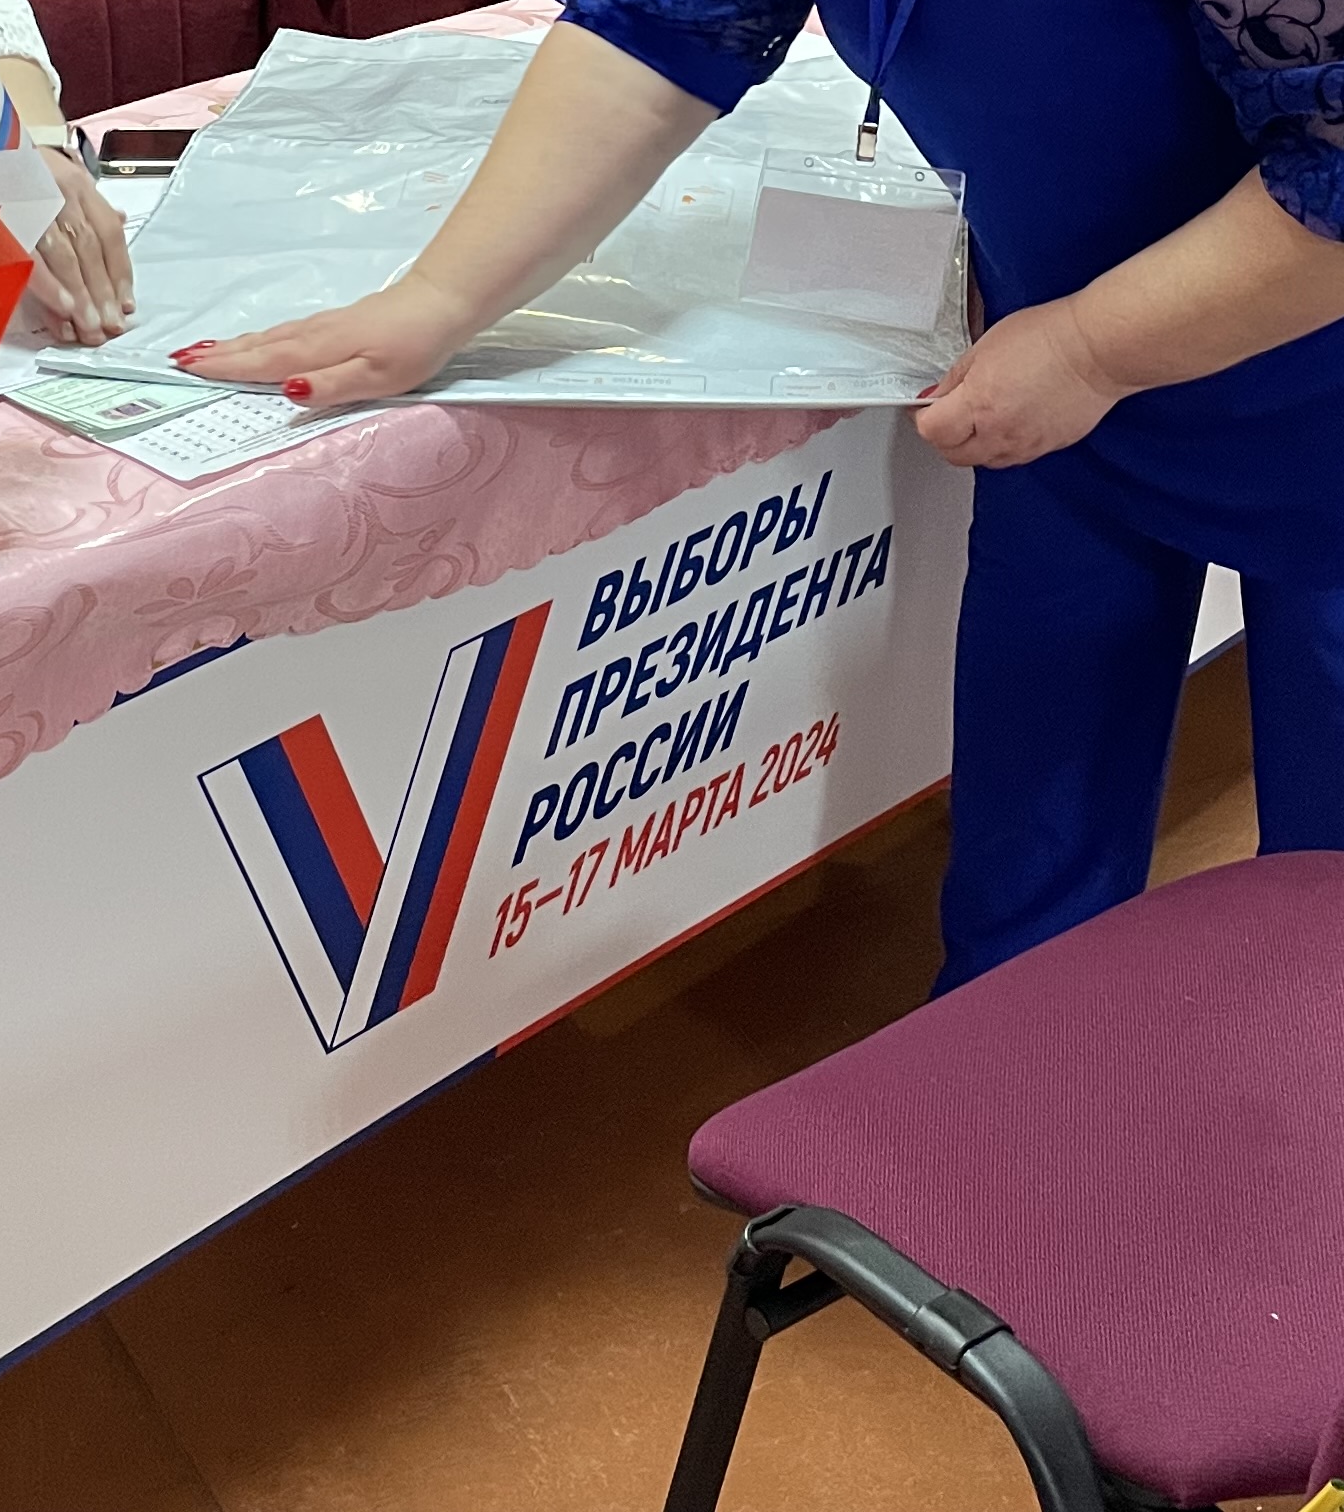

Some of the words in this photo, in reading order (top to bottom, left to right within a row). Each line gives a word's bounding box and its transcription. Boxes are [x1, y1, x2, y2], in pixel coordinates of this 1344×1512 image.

[544, 526, 894, 760] ПРЕЗИДЕНТА
[578, 470, 833, 651] ВЫБОРЫ
[511, 681, 750, 868] РОССИИ
[609, 762, 747, 889] МАРТА
[749, 711, 843, 806] 2024
